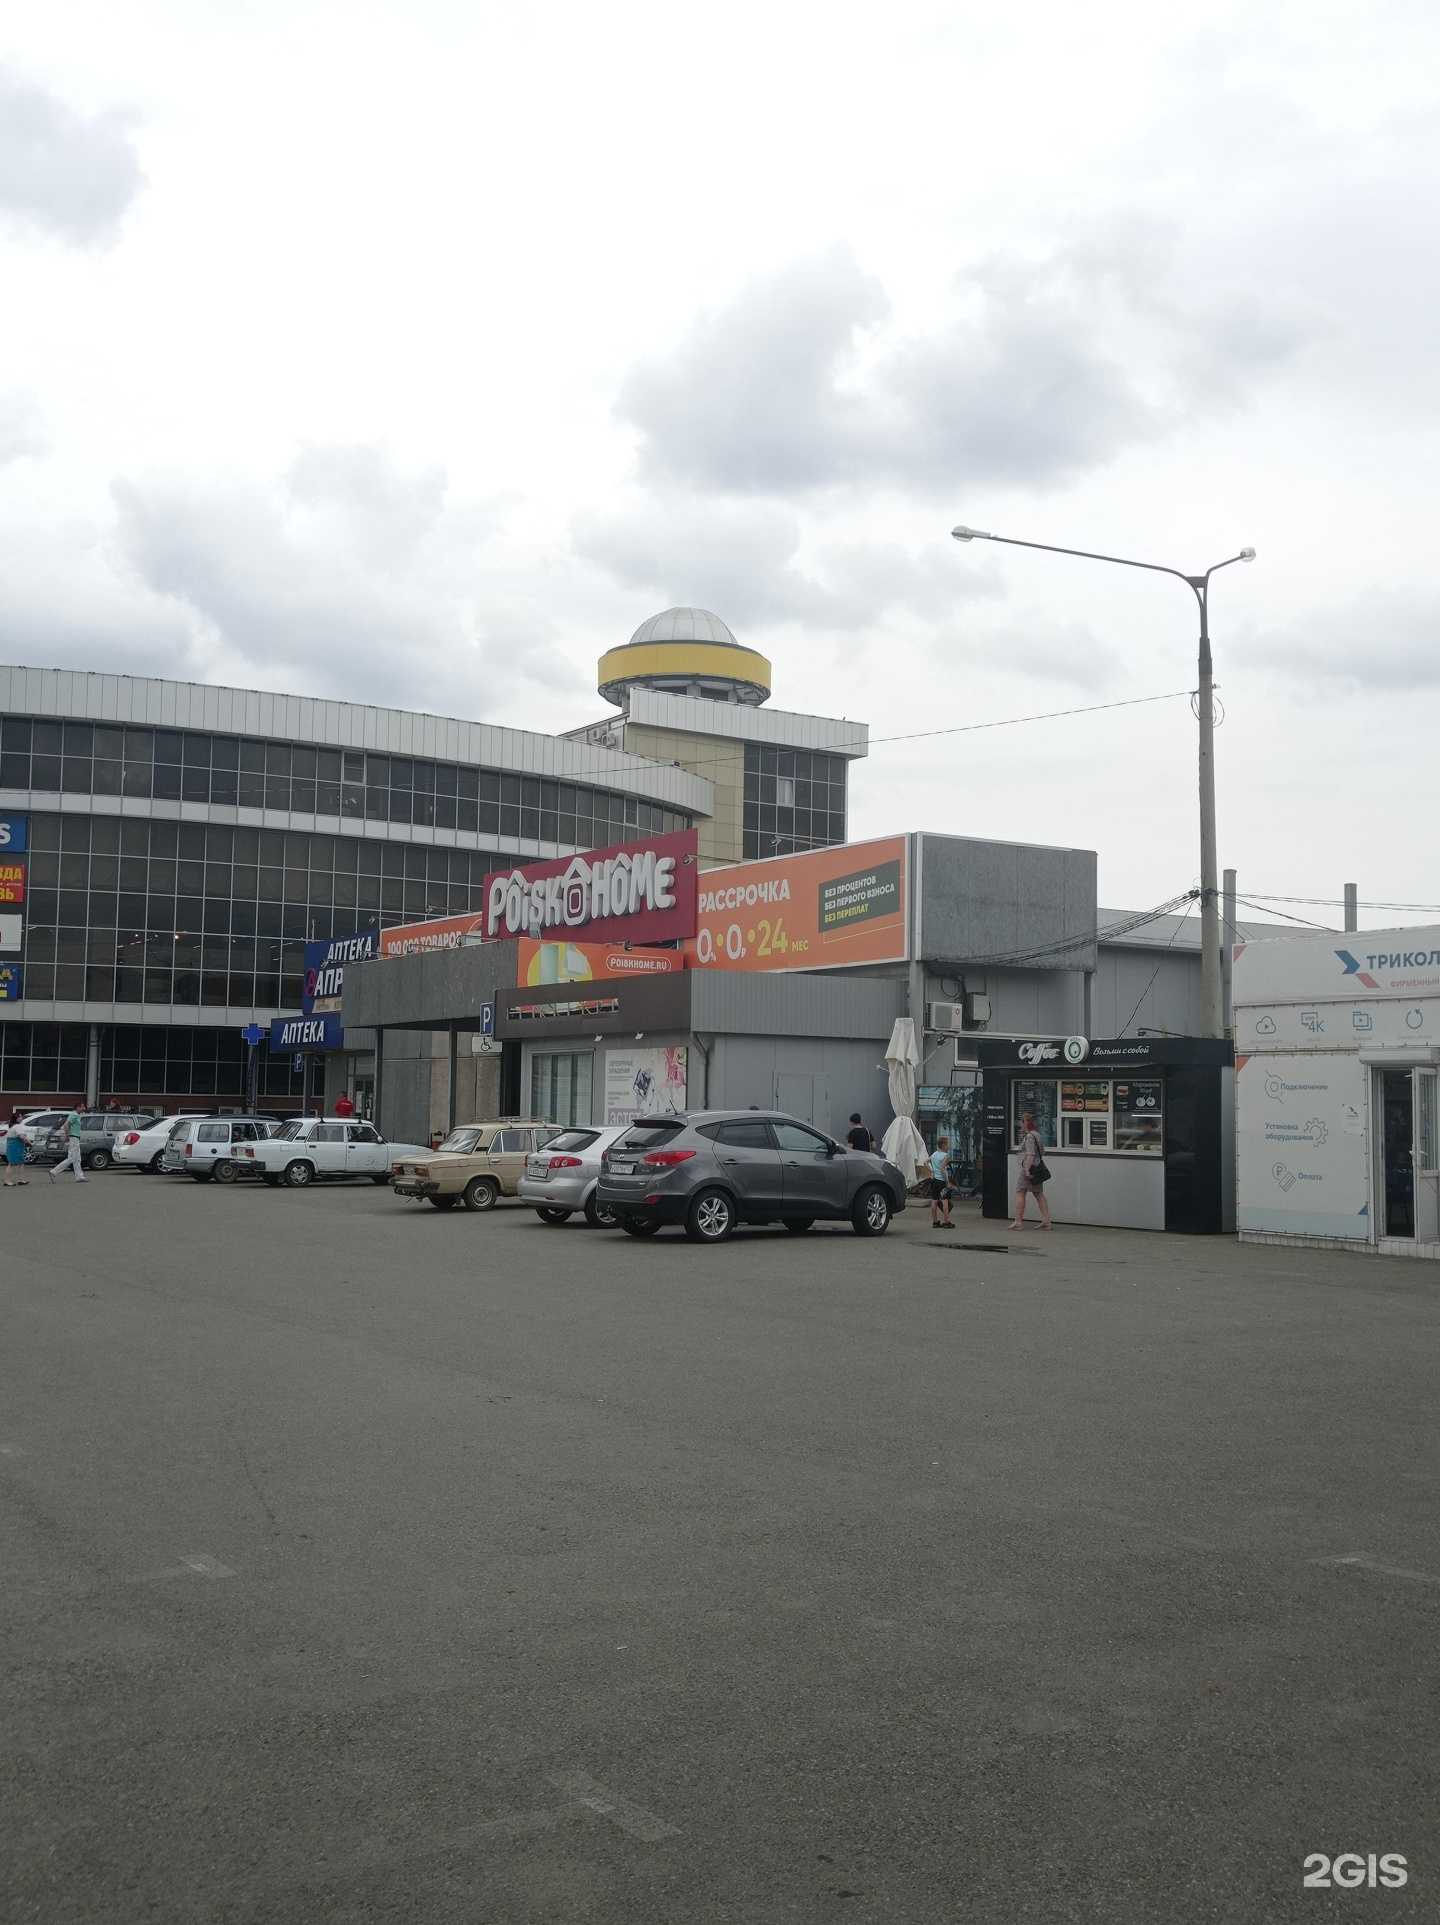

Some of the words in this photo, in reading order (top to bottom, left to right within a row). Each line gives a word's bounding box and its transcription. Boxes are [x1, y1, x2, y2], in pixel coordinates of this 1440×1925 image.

[698, 879, 791, 913] РАССРОЧКА
[825, 888, 836, 898] БЕЗ
[837, 876, 876, 895] ПРОЦЕНТОВ
[825, 900, 836, 911] БЕЗ
[837, 891, 866, 907] ПЕРВОГО
[867, 883, 895, 898] ВЗНОСА
[825, 912, 836, 923] БЕЗ
[757, 917, 788, 956] 24
[791, 939, 809, 952] МЕС
[327, 936, 373, 961] АПТЕКА
[610, 958, 668, 970] POISKHOME.RU
[1366, 951, 1440, 969] ТРИКОЛ
[281, 1021, 324, 1044] АПТЕКА
[1019, 1043, 1060, 1064] Coffee
